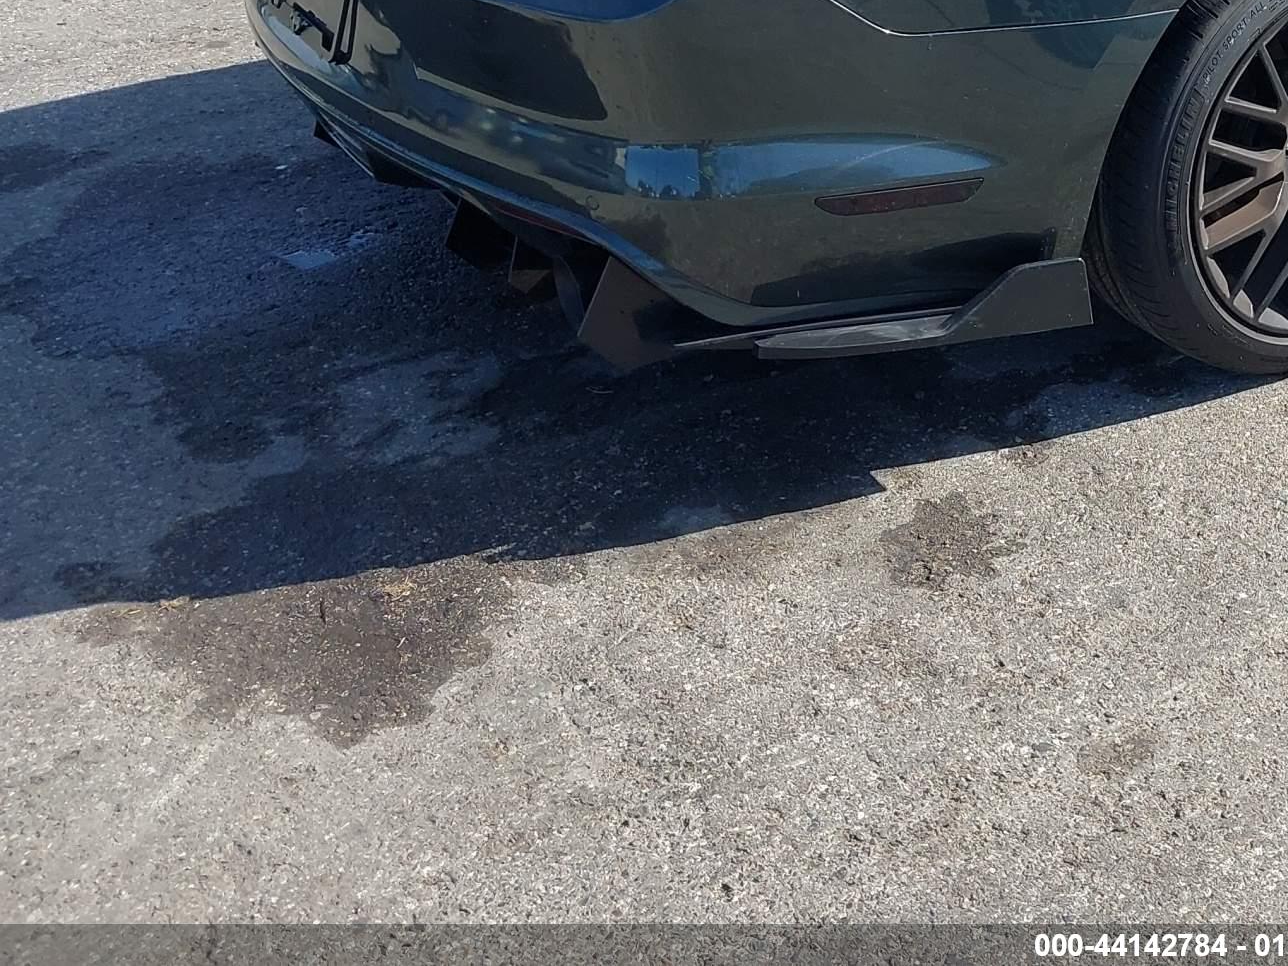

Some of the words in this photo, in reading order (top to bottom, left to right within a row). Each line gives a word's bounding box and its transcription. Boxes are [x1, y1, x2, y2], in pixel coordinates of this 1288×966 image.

[1202, 53, 1223, 84] PILOT
[1222, 17, 1248, 50] SPORT
[1249, 1, 1267, 19] ALL
[1165, 96, 1201, 232] MICHELIN
